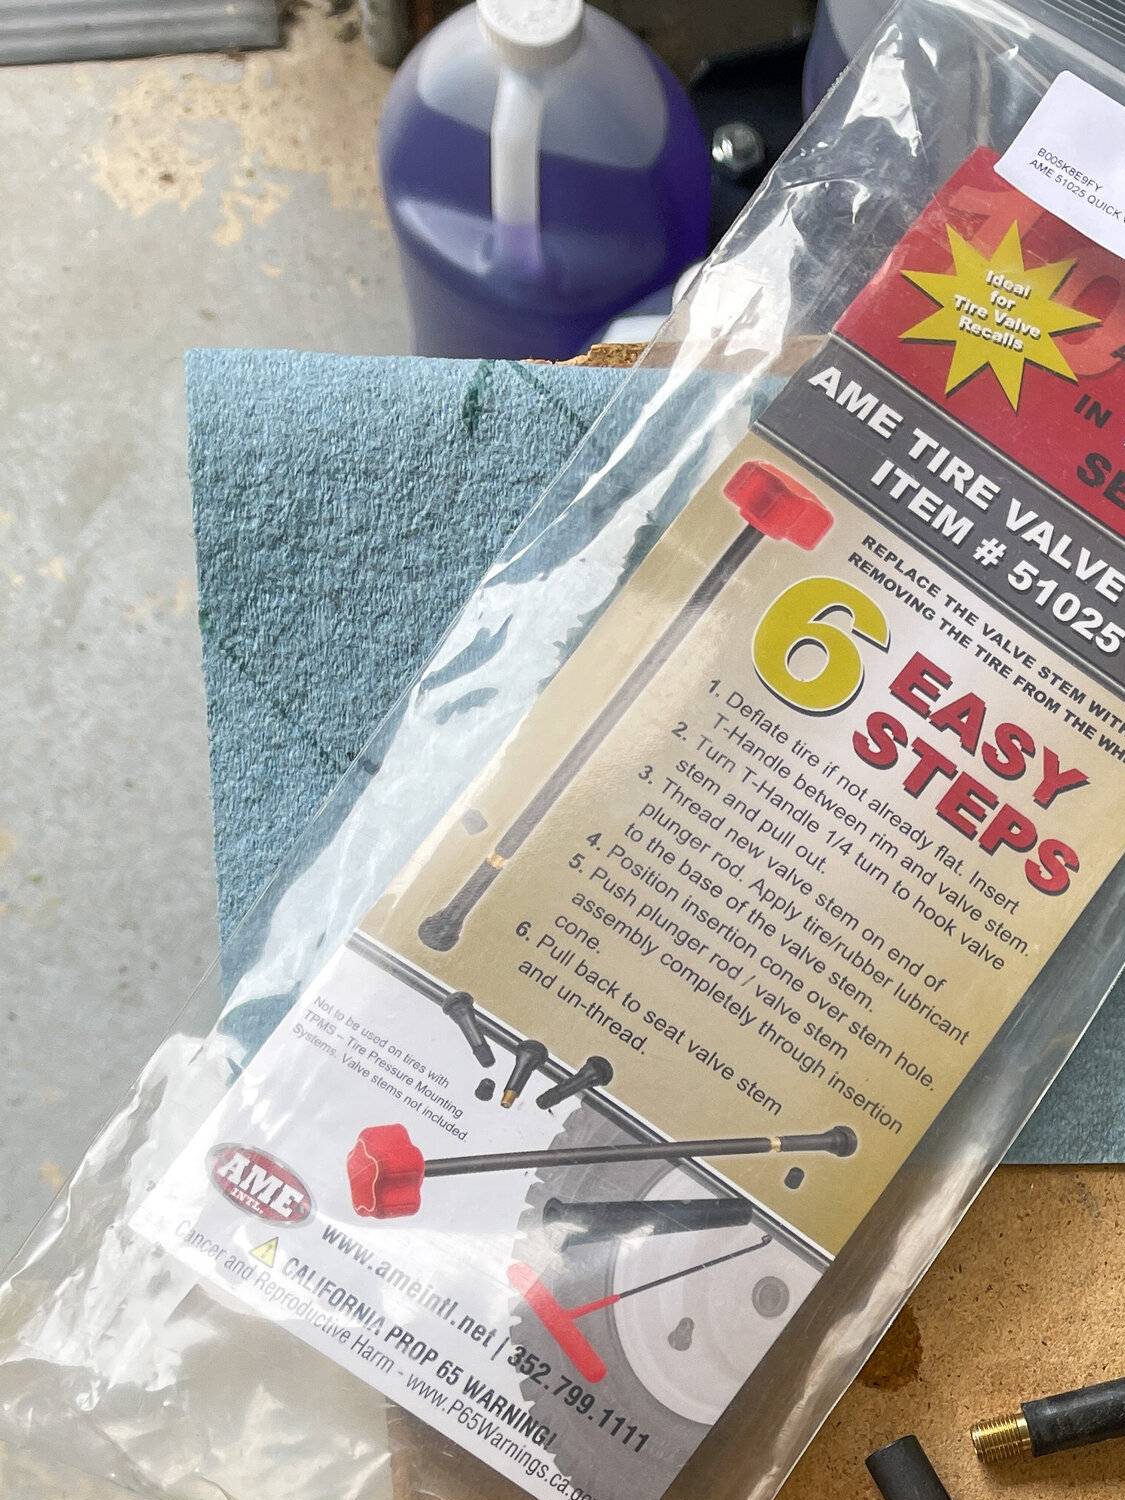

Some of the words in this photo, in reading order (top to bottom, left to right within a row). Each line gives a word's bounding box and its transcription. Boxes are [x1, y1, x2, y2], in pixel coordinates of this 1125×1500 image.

[1028, 158, 1054, 178] AME
[1054, 173, 1086, 198] 51025
[1086, 193, 1122, 220] QUICK
[1036, 146, 1102, 192] B005K8E9FY
[953, 293, 989, 321] Tire
[994, 309, 1042, 341] Valve
[958, 316, 1025, 353] Recalls
[984, 269, 1032, 301] Ideal
[989, 290, 1017, 313] for
[808, 366, 902, 437] AME
[909, 428, 1000, 509] TIRE
[1073, 393, 1112, 429] IN
[860, 534, 942, 598] REPLACE
[942, 593, 980, 627] THE
[980, 622, 1037, 669] VALVE
[1036, 665, 1087, 705] STEM
[871, 460, 973, 543] ITEM
[972, 537, 1007, 565] #
[1007, 560, 1125, 652] 51025
[752, 574, 891, 716] 6
[846, 551, 937, 621] REMOVING
[937, 616, 974, 649] THE
[973, 643, 1014, 679] TIRE
[1011, 673, 1062, 714] FROM
[1062, 708, 1098, 740] THE
[707, 678, 722, 698] 1.
[724, 690, 790, 745] Deflate
[790, 739, 821, 768] tire
[821, 761, 840, 779] if
[835, 774, 868, 802] not
[865, 797, 934, 852] already
[932, 843, 965, 877] flat.
[967, 870, 1020, 915] Insert
[853, 712, 1078, 895] STEPS
[890, 653, 1087, 807] EASY
[637, 763, 655, 785] 3.
[660, 776, 726, 831] Thread
[723, 827, 765, 860] new
[765, 855, 814, 896] valve
[813, 892, 860, 931] stem
[860, 927, 885, 951] on
[886, 945, 925, 977] end
[922, 972, 947, 993] of
[670, 720, 690, 741] 2.
[695, 734, 737, 774] Turn
[739, 766, 821, 833] T-Handle
[824, 829, 854, 857] 1/4
[853, 851, 890, 886] turn
[890, 879, 911, 901] to
[910, 894, 958, 937] hook
[958, 930, 1006, 971] valve
[674, 758, 721, 796] stem
[721, 791, 761, 823] and
[756, 817, 796, 849] pull
[794, 844, 828, 874] out.
[711, 712, 792, 779] T-Handle
[792, 772, 869, 836] between
[868, 830, 899, 859] rim
[899, 854, 938, 886] and
[936, 881, 983, 922] valve
[983, 917, 1030, 957] stem.
[553, 913, 602, 954] cone.
[567, 852, 587, 874] 5.
[588, 865, 638, 907] Push
[634, 902, 710, 957] plunger
[707, 951, 744, 981] rod
[739, 973, 756, 988] /
[753, 983, 802, 1025] valve
[802, 1021, 849, 1060] stem
[585, 831, 603, 851] 4.
[605, 843, 680, 902] Position
[679, 895, 758, 959] insertion
[758, 954, 805, 993] cone
[805, 989, 848, 1023] over
[847, 1019, 893, 1058] stem
[893, 1051, 936, 1092] hole.
[623, 822, 644, 843] to
[645, 836, 676, 866] the
[676, 858, 724, 899] base
[724, 894, 749, 915] of
[745, 907, 777, 937] the
[778, 932, 827, 974] valve
[827, 970, 875, 1013] stem.
[637, 801, 712, 855] plunger
[709, 850, 747, 882] rod.
[746, 877, 802, 922] Apply
[801, 914, 895, 988] tire/rubber
[892, 981, 970, 1046] lubricant
[303, 1008, 337, 1036] TPMS
[346, 1036, 367, 1055] Tire
[366, 1049, 414, 1086] Pressure
[414, 1080, 464, 1119] Mounting
[313, 995, 334, 1015] Not
[332, 1008, 345, 1021] to
[344, 1016, 361, 1031] be
[360, 1027, 388, 1048] used
[386, 1044, 402, 1058] on
[402, 1053, 427, 1074] tires
[426, 1069, 449, 1089] with
[514, 920, 533, 941] 6.
[535, 933, 576, 967] Pull
[573, 958, 620, 999] back
[620, 991, 642, 1014] to
[641, 1009, 686, 1045] seat
[685, 1038, 735, 1081] valve
[735, 1076, 783, 1116] stem
[517, 959, 558, 990] and
[556, 984, 649, 1055] un-thread.
[569, 891, 660, 957] assembly
[657, 951, 758, 1028] completely
[756, 1020, 827, 1080] through
[826, 1071, 904, 1135] insertion
[341, 1052, 370, 1078] Valve
[370, 1073, 403, 1099] stems
[402, 1095, 422, 1112] not
[421, 1106, 469, 1141] included.
[216, 1151, 303, 1217] AME
[229, 1186, 264, 1214] INTL.
[176, 1219, 227, 1259] Cancer
[223, 1253, 256, 1281] and
[252, 1270, 353, 1349] Reproductive
[349, 1333, 395, 1373] Harm
[285, 1256, 386, 1336] CALIFORNIA
[383, 1324, 439, 1367] PROP
[435, 1358, 464, 1386] 65
[461, 1375, 559, 1451] WARNING!
[321, 1223, 497, 1348] www.ameintl.net
[506, 1345, 650, 1453] 352.799.1111
